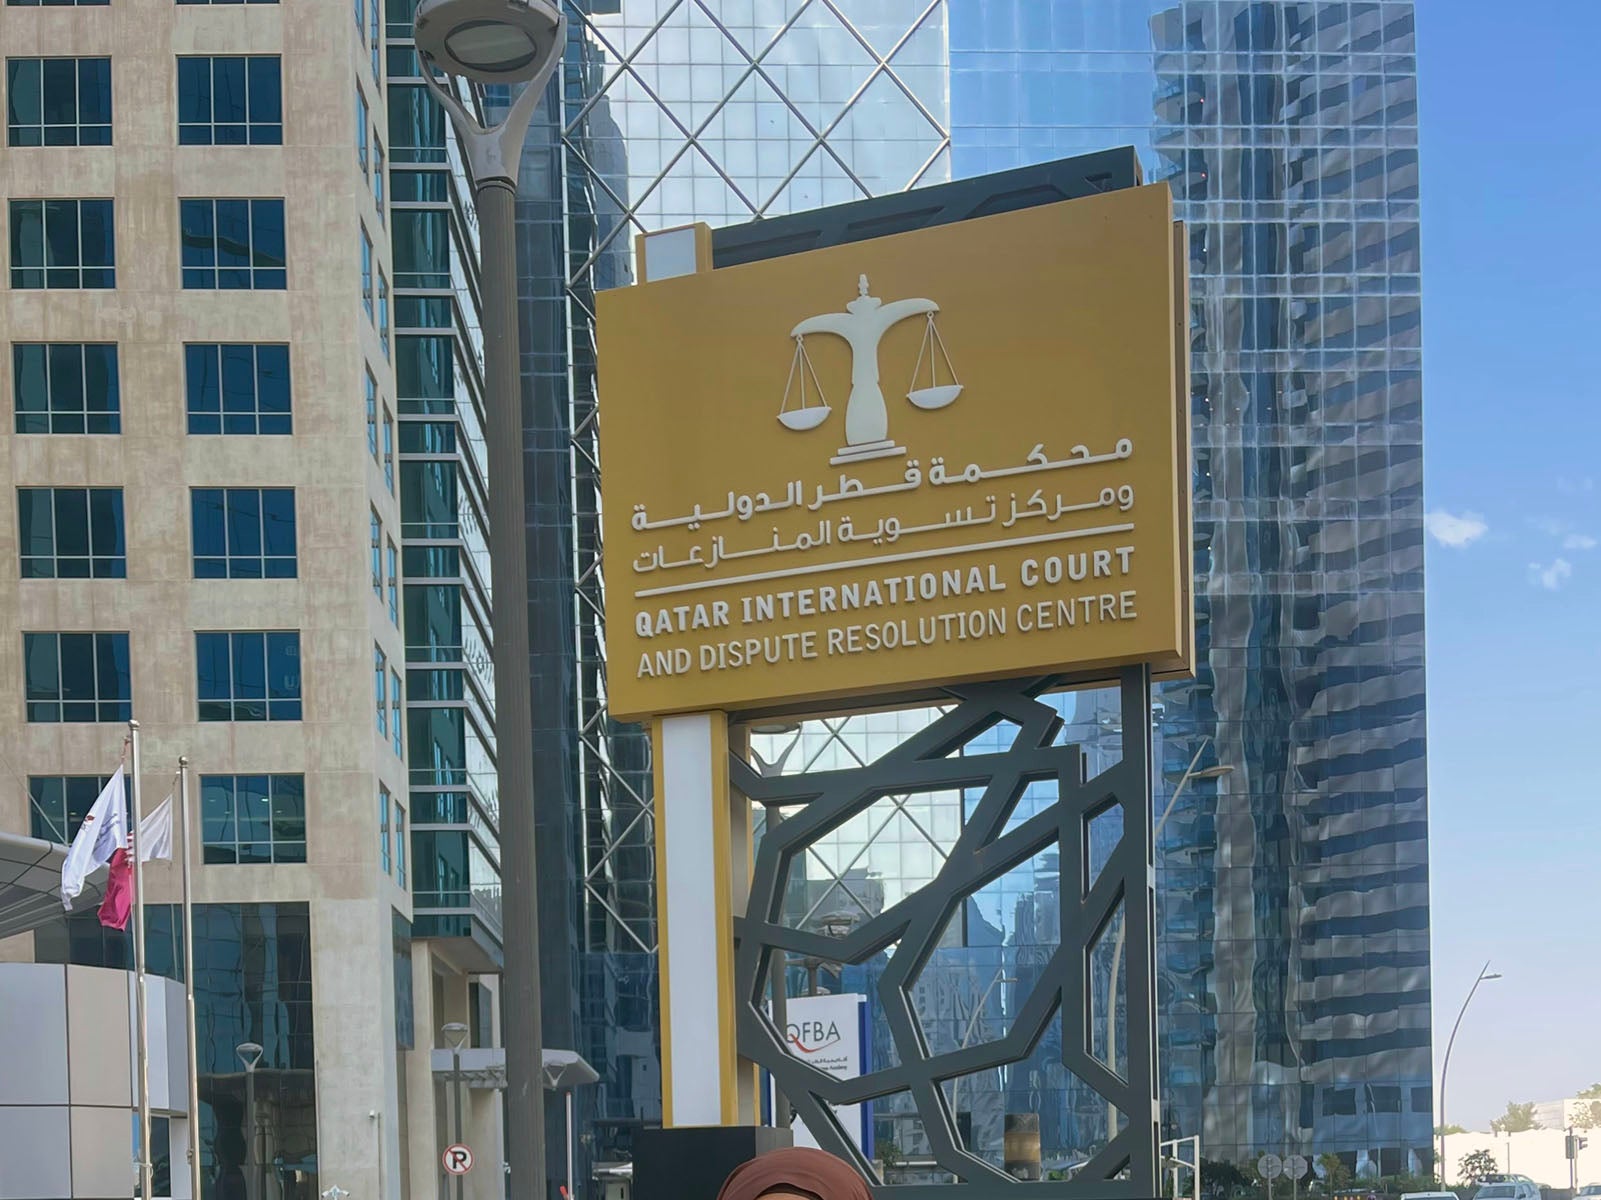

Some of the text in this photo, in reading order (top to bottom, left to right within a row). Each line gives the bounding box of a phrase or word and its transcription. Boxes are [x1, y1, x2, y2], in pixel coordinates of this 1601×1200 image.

[631, 438, 1133, 530] محكمة قطر الدولية
[633, 484, 1134, 573] ومركز تسوية المنازعات
[635, 546, 1135, 638] QATAR INTERNATIONAL COURT
[637, 590, 1137, 678] AND DISPUTE RESOLUTION CENTRE
[786, 1021, 841, 1052] QFBA
[452, 1151, 467, 1169] P
